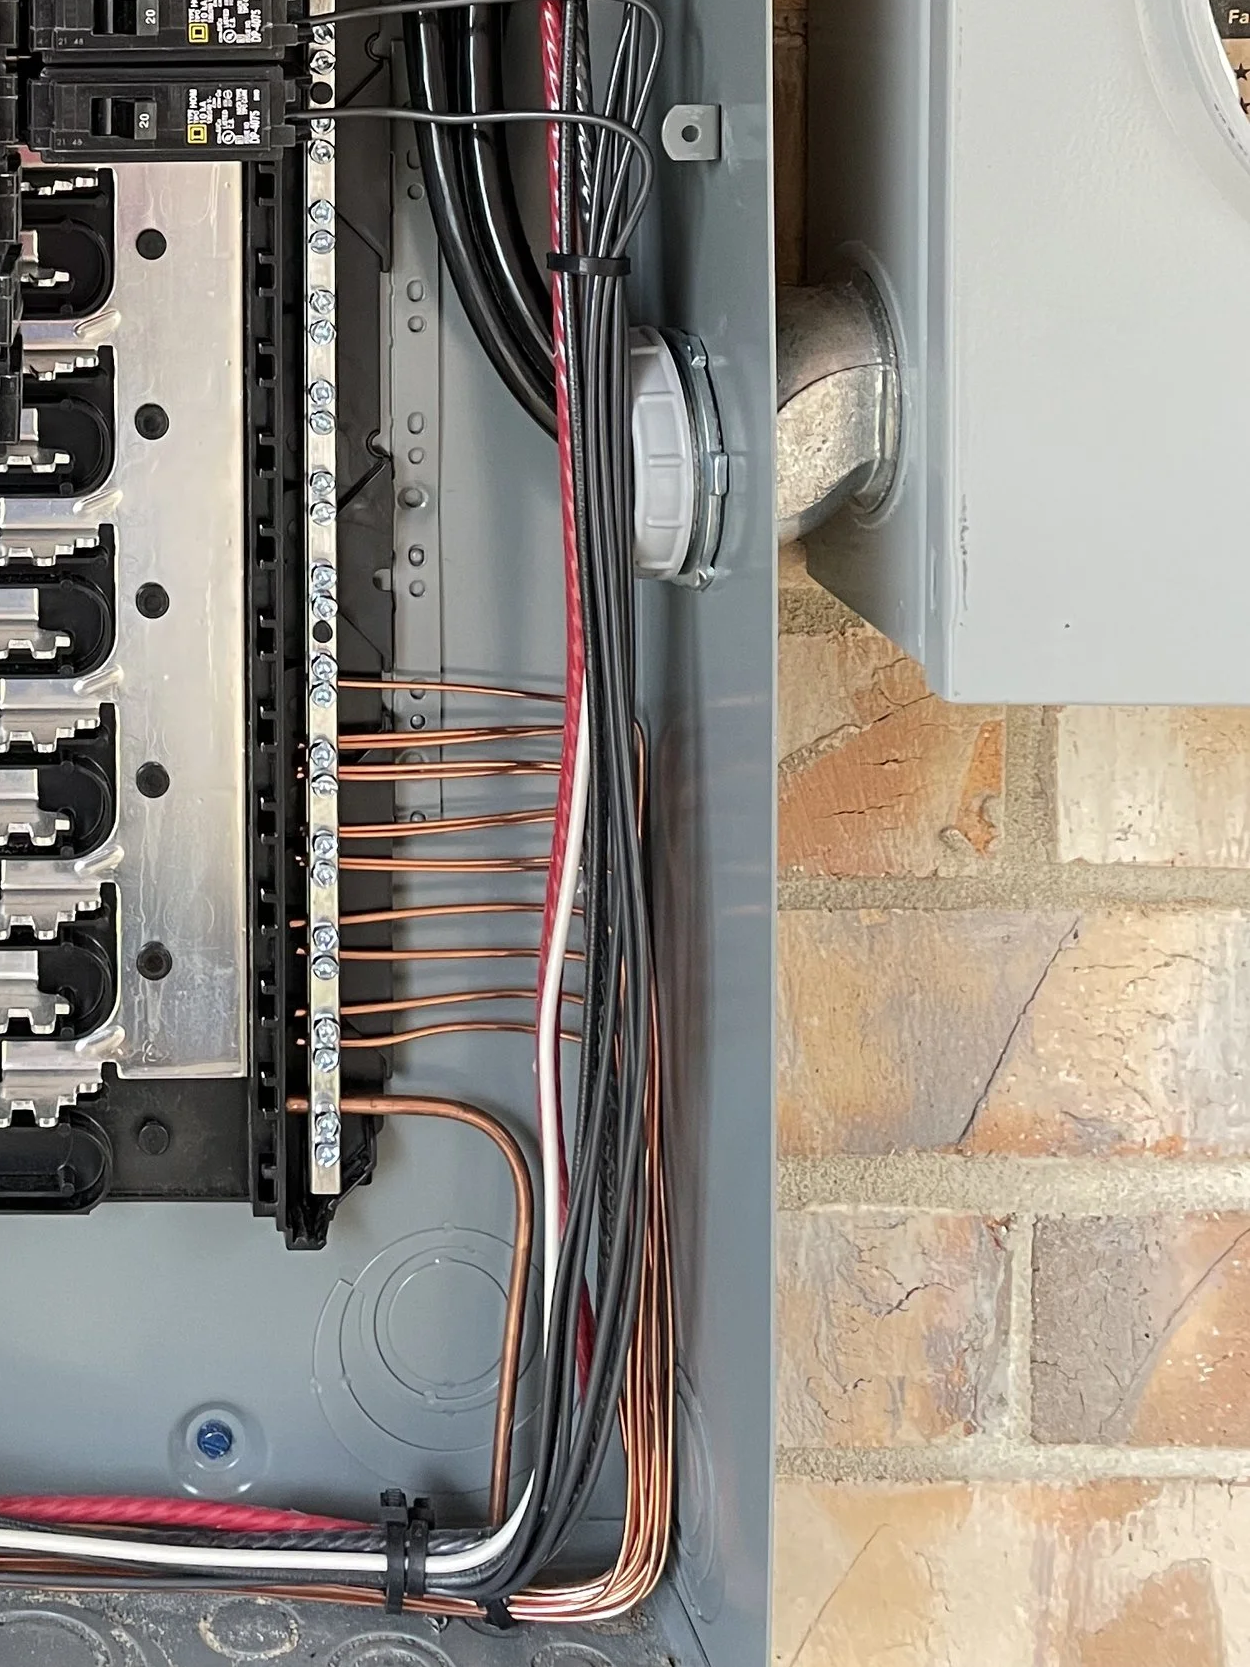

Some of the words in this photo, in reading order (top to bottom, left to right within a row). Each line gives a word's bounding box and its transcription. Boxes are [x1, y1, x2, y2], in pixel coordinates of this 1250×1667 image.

[146, 8, 156, 24] 20
[1229, 10, 1249, 24] Fa
[251, 10, 261, 42] DP-4075
[138, 113, 149, 128] 20
[250, 110, 260, 144] DP-4075
